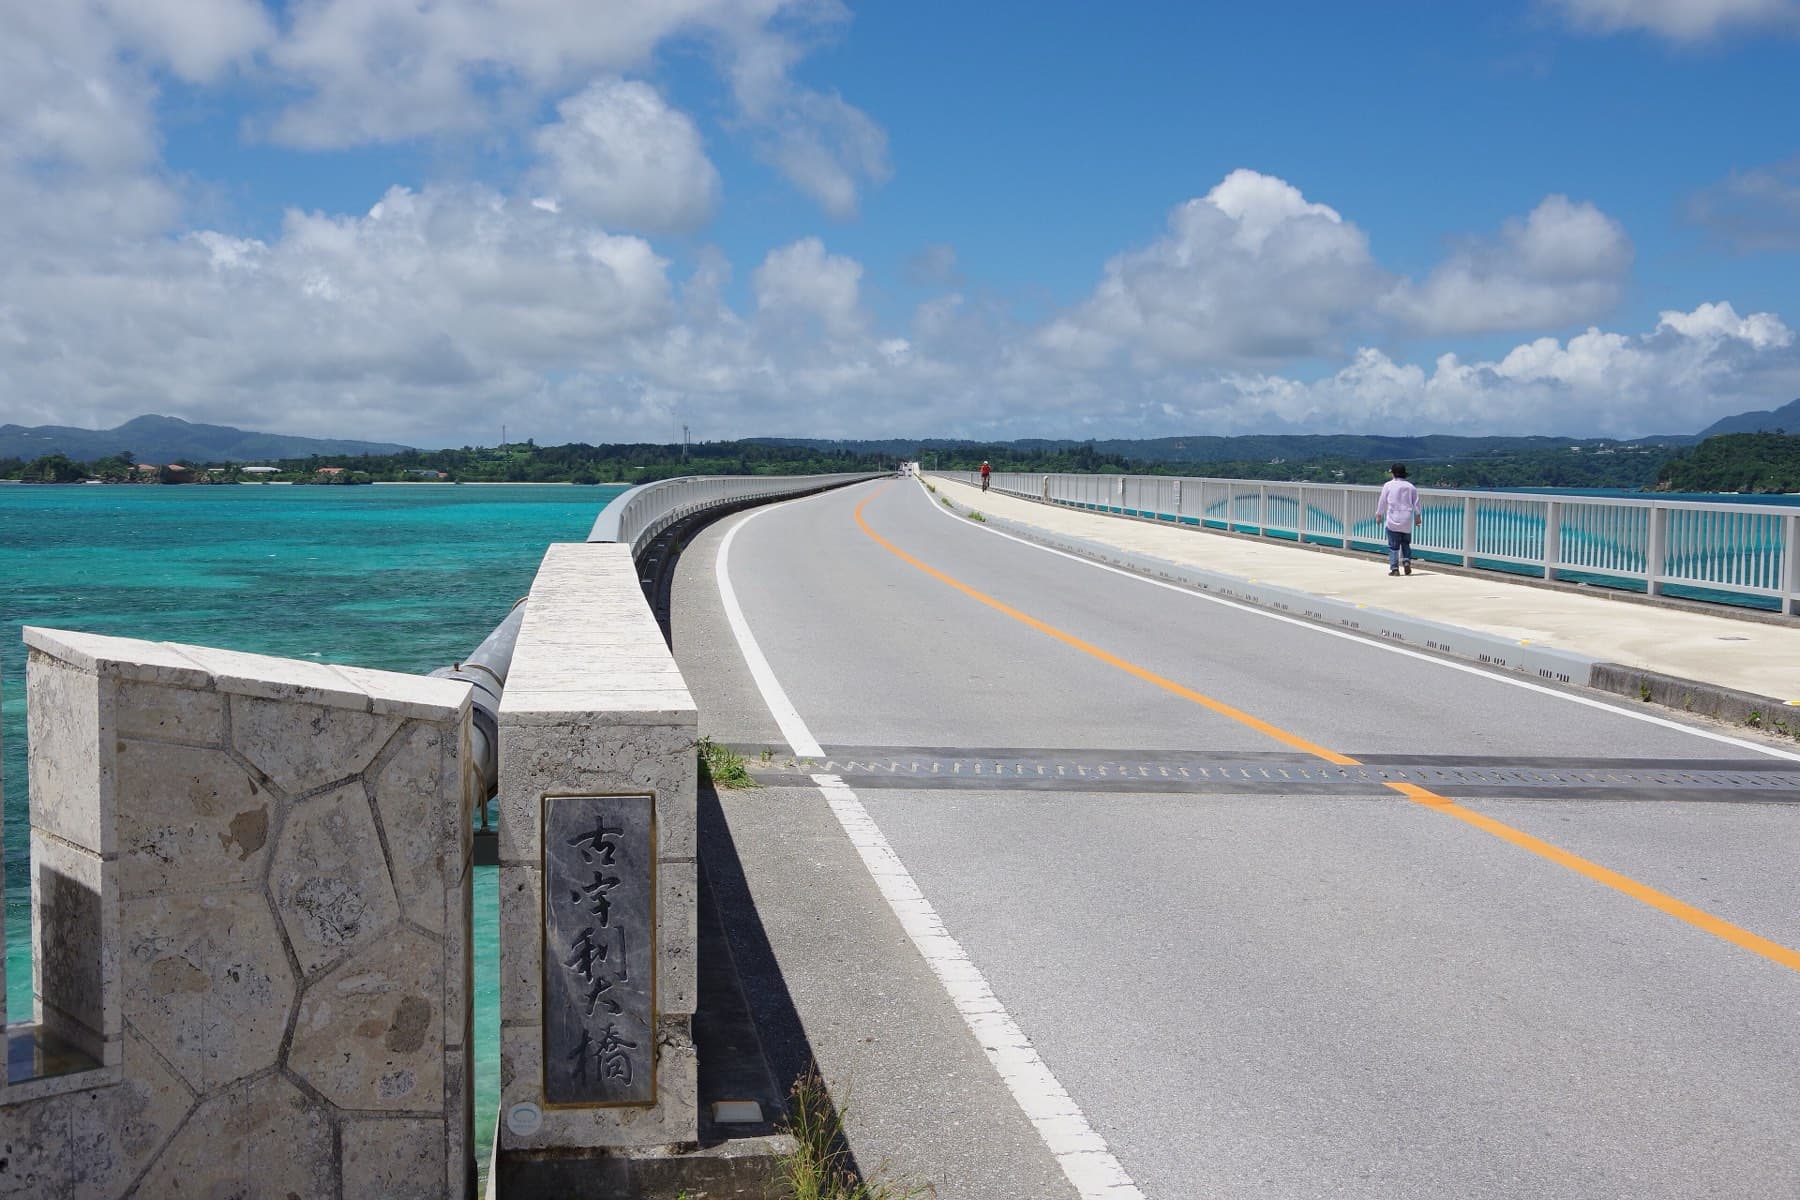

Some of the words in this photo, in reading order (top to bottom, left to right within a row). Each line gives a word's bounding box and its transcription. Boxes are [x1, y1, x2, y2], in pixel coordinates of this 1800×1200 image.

[564, 815, 637, 1087] 古宇利大橋
